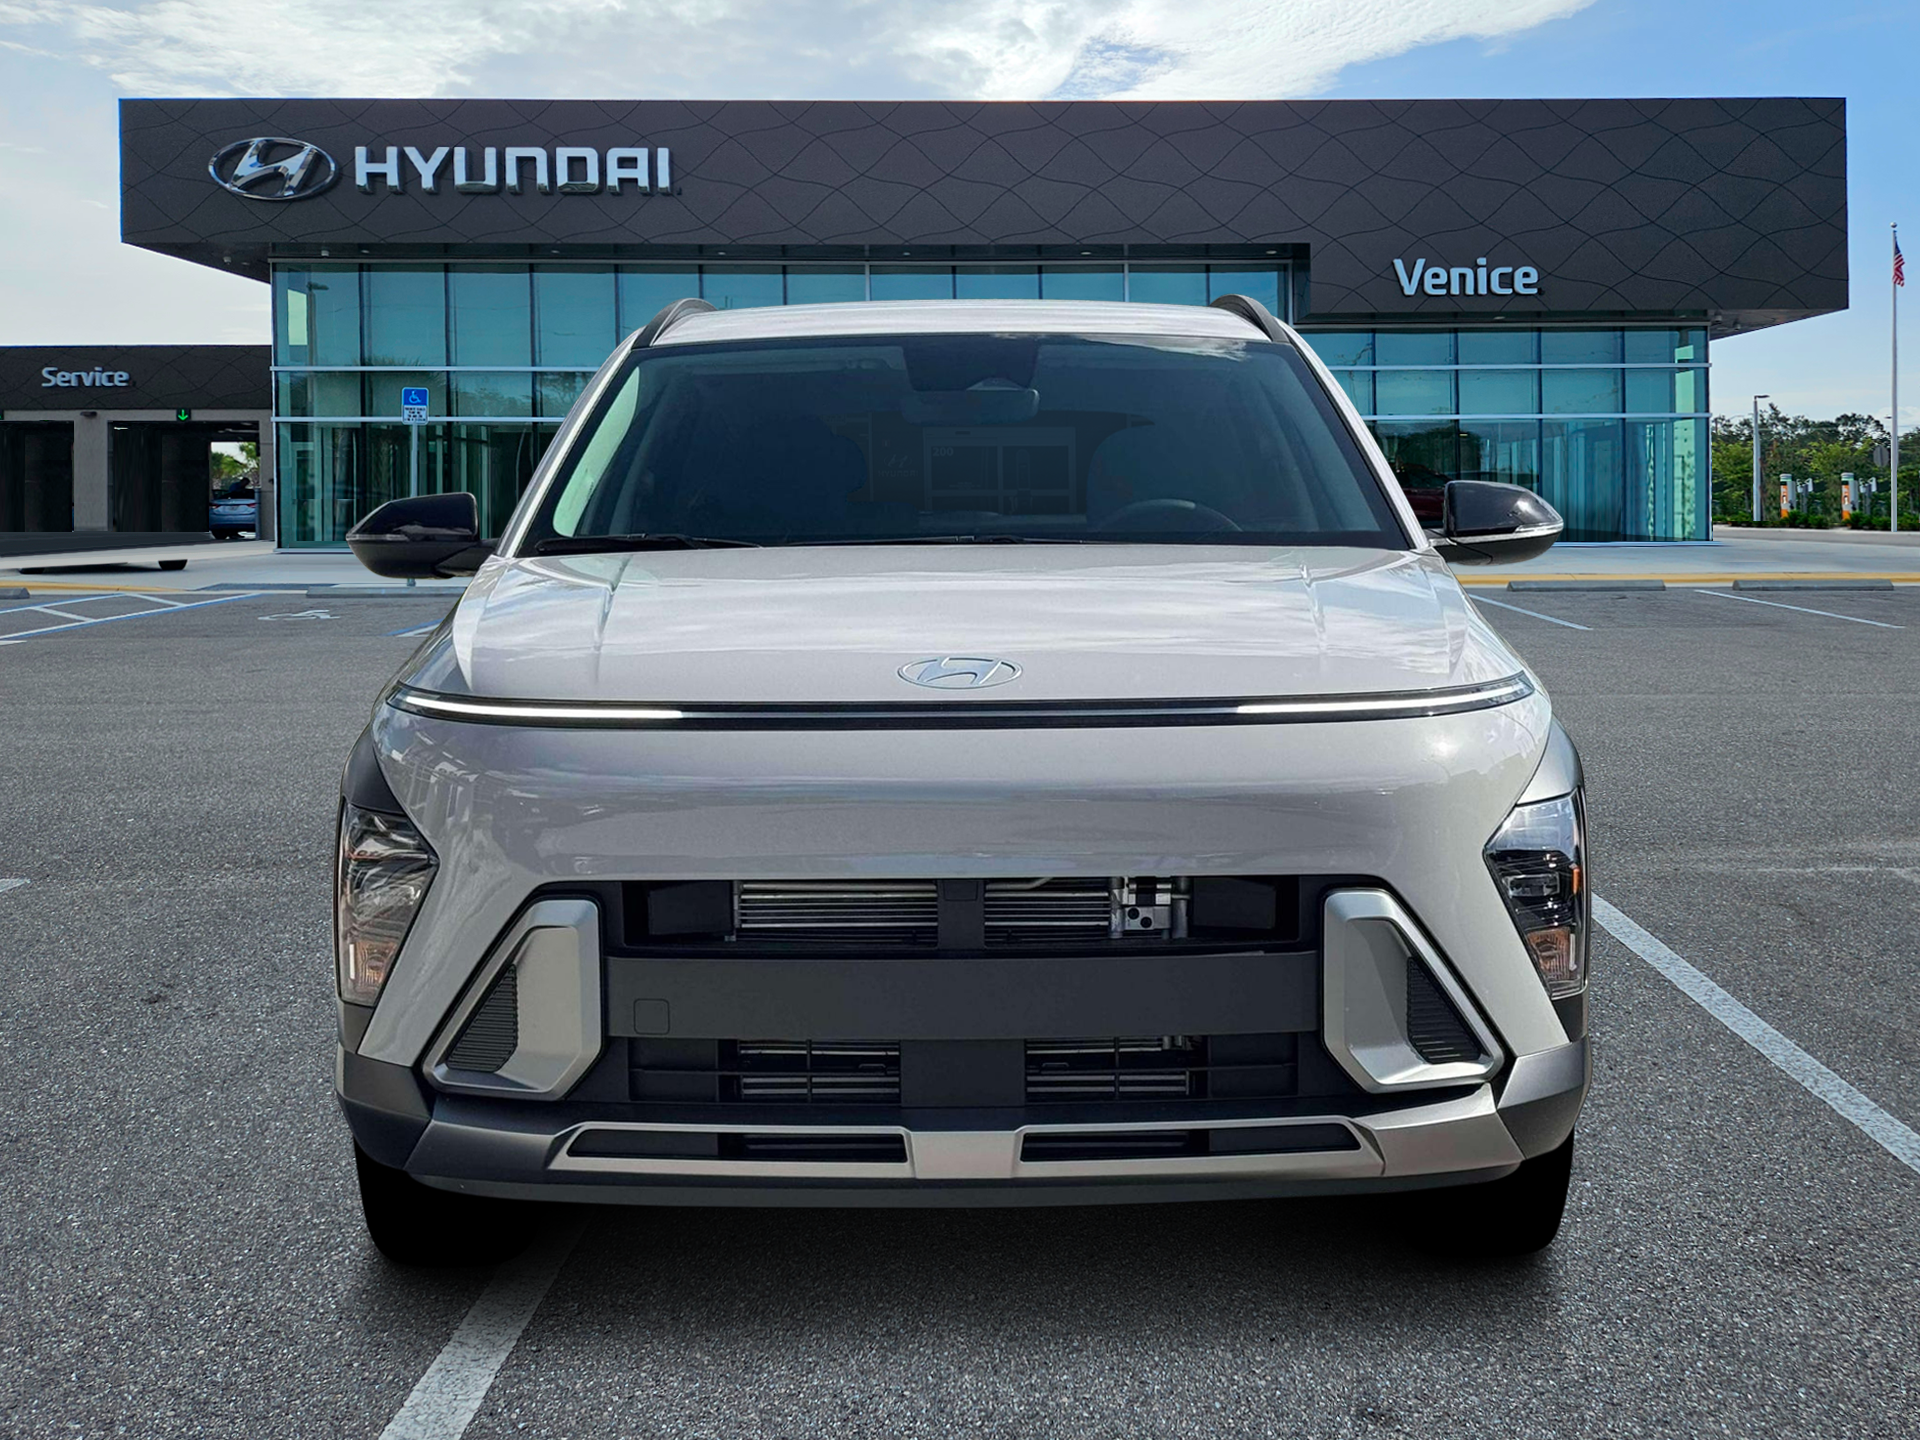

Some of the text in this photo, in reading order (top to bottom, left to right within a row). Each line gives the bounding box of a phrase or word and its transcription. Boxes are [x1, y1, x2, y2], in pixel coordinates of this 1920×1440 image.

[354, 146, 671, 194] HYUNDAI
[1393, 257, 1539, 296] Venice
[41, 366, 130, 387] Service
[932, 447, 954, 457] 200
